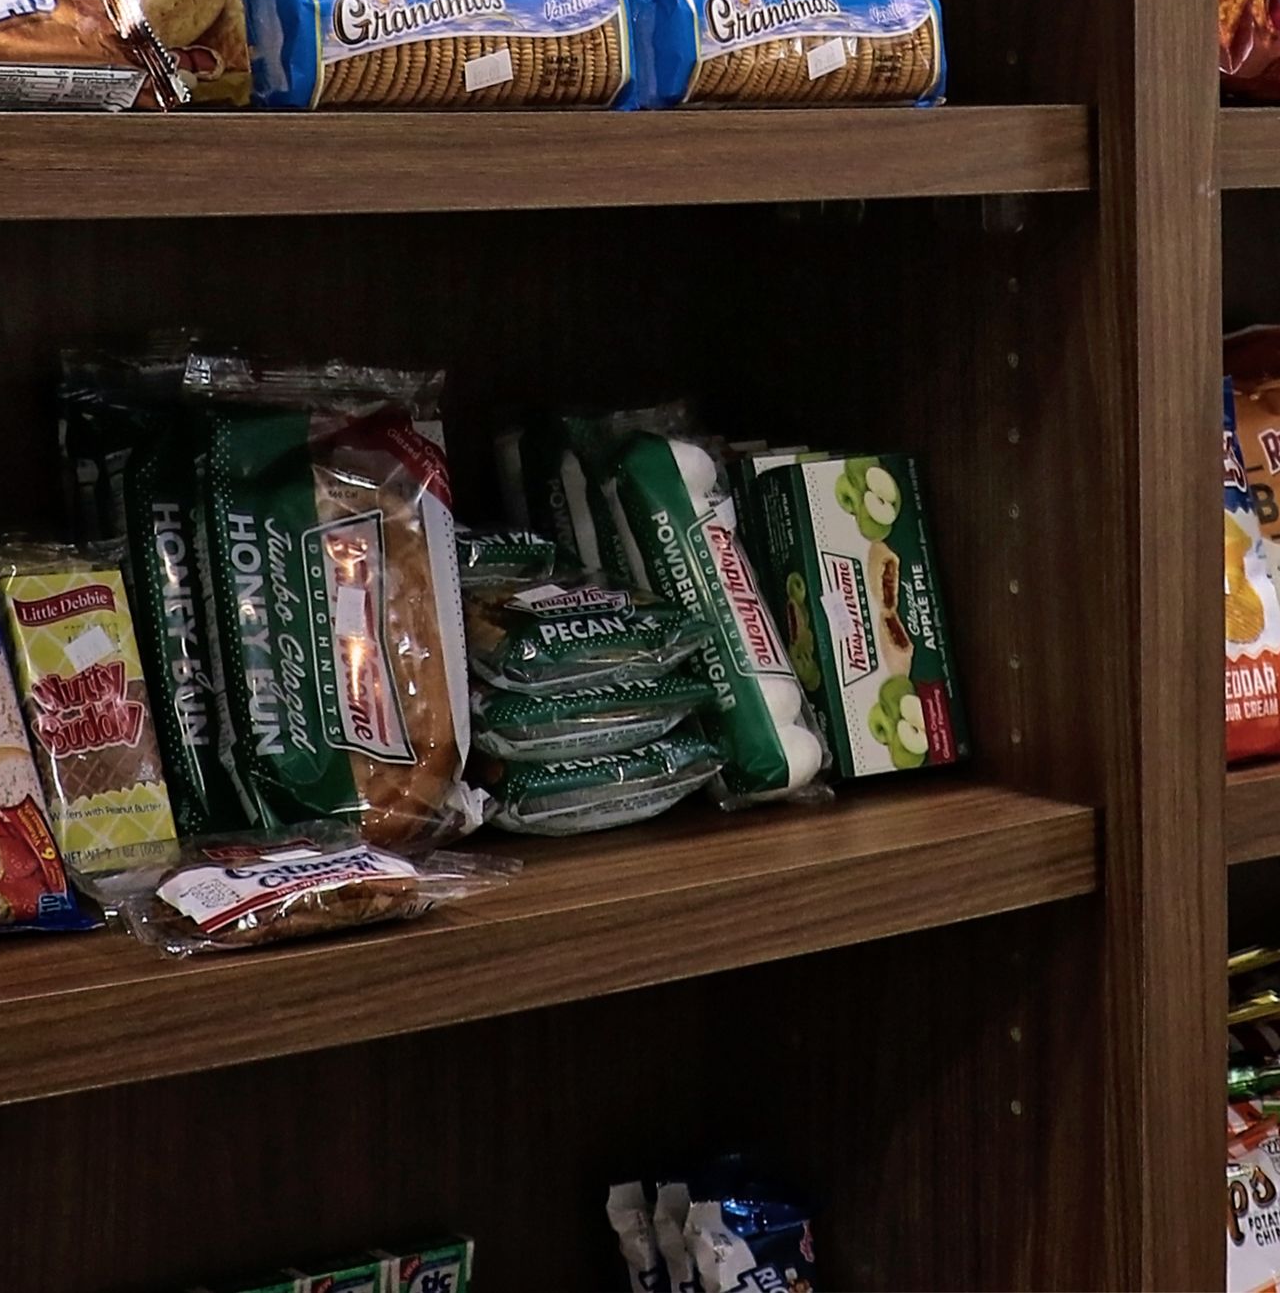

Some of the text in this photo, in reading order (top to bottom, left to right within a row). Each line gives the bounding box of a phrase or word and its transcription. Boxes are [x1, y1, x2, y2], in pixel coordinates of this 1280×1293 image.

[21, 587, 108, 622] Little Debbie
[152, 504, 210, 746] HONEY BUN
[228, 513, 284, 756] HONEY BUN
[265, 517, 317, 754] Jumbo Glazed
[308, 543, 341, 738] DOUGHNUTS
[540, 616, 627, 646] PECAN
[691, 534, 751, 669] DOUGHNUTS
[707, 521, 773, 668] Krispy Kreme
[855, 561, 878, 668] DOUGHNUTS
[901, 580, 921, 637] Glazed
[911, 564, 937, 650] APPLE PIE
[32, 661, 126, 709] Nutty
[32, 700, 143, 757] Buddy
[1244, 700, 1279, 718] CREAM
